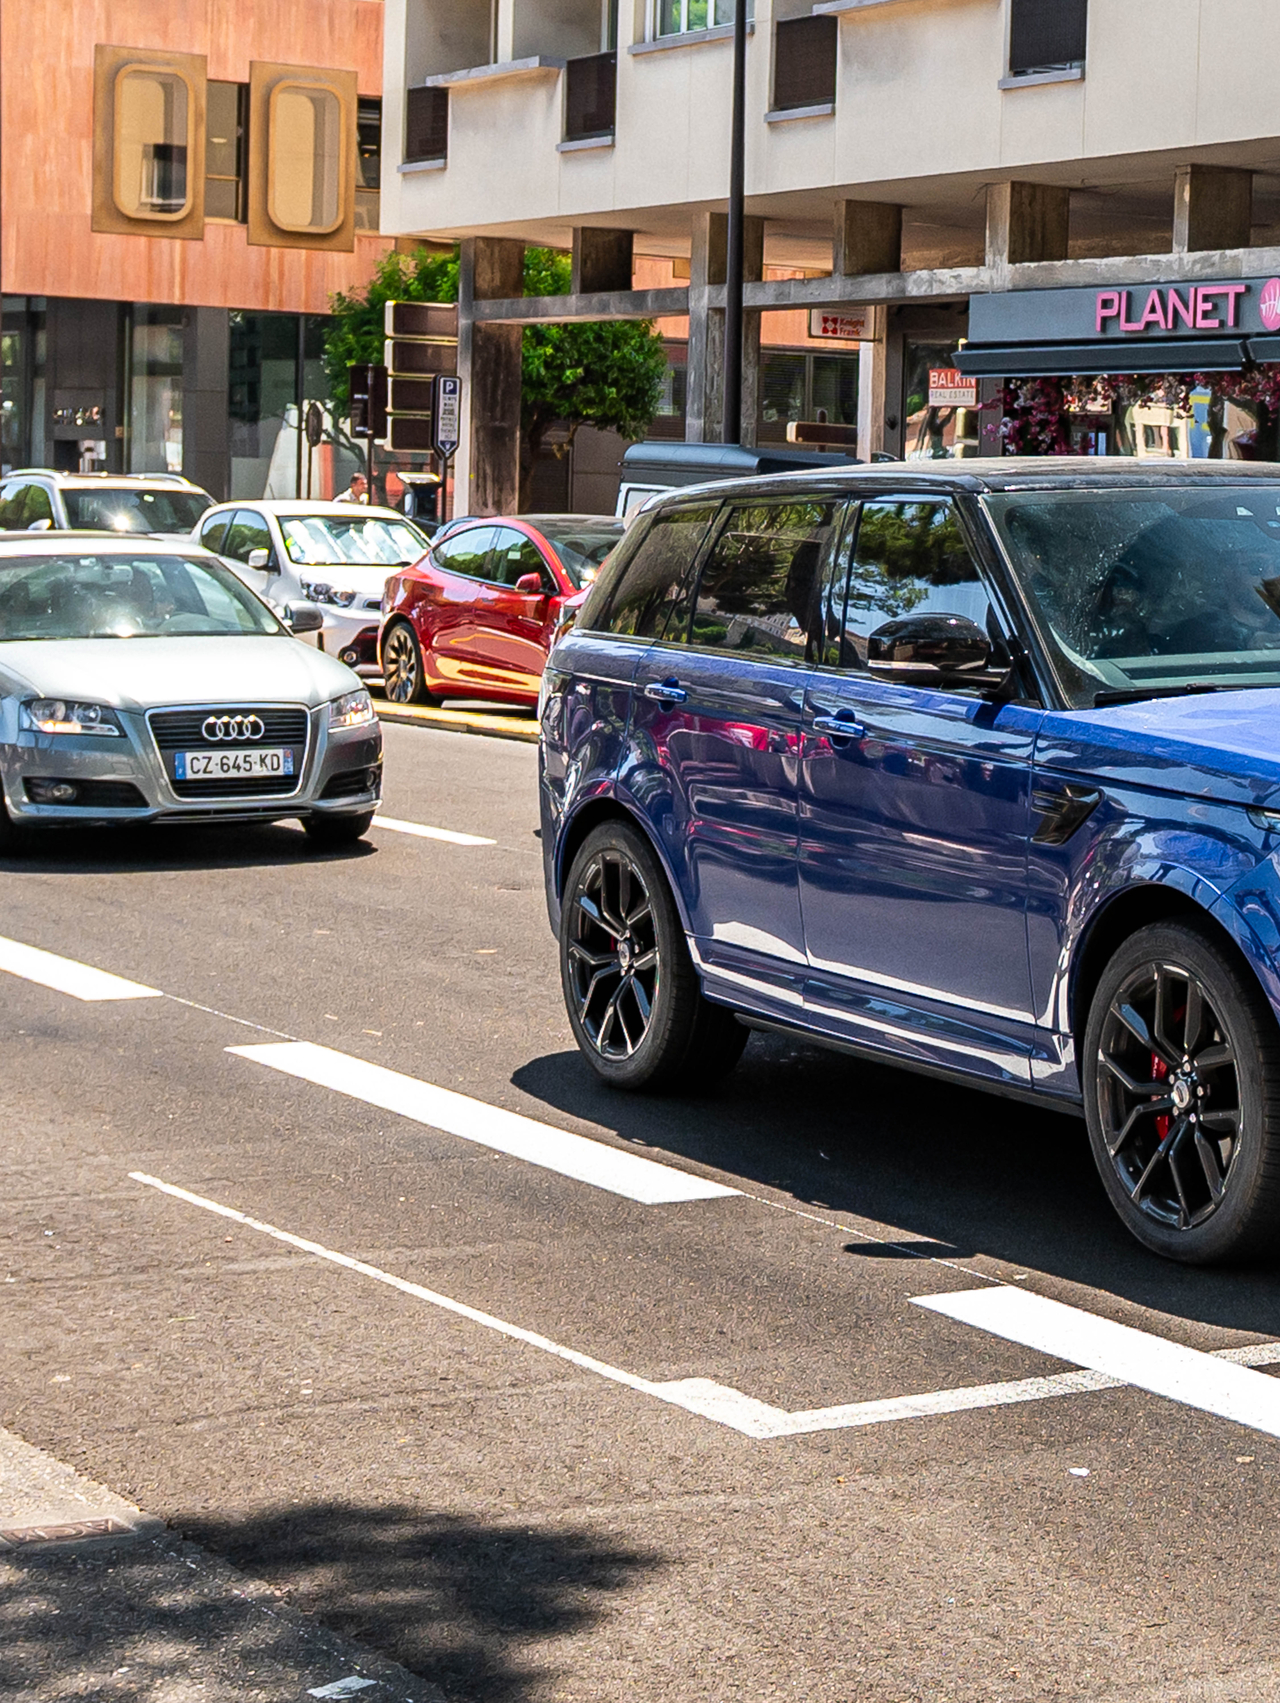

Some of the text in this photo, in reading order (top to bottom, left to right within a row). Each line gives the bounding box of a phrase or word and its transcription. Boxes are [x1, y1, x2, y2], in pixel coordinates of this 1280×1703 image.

[1095, 284, 1246, 333] PLANET
[930, 371, 976, 387] BALKIN
[445, 381, 454, 394] P
[931, 390, 974, 399] REAL ESTATE
